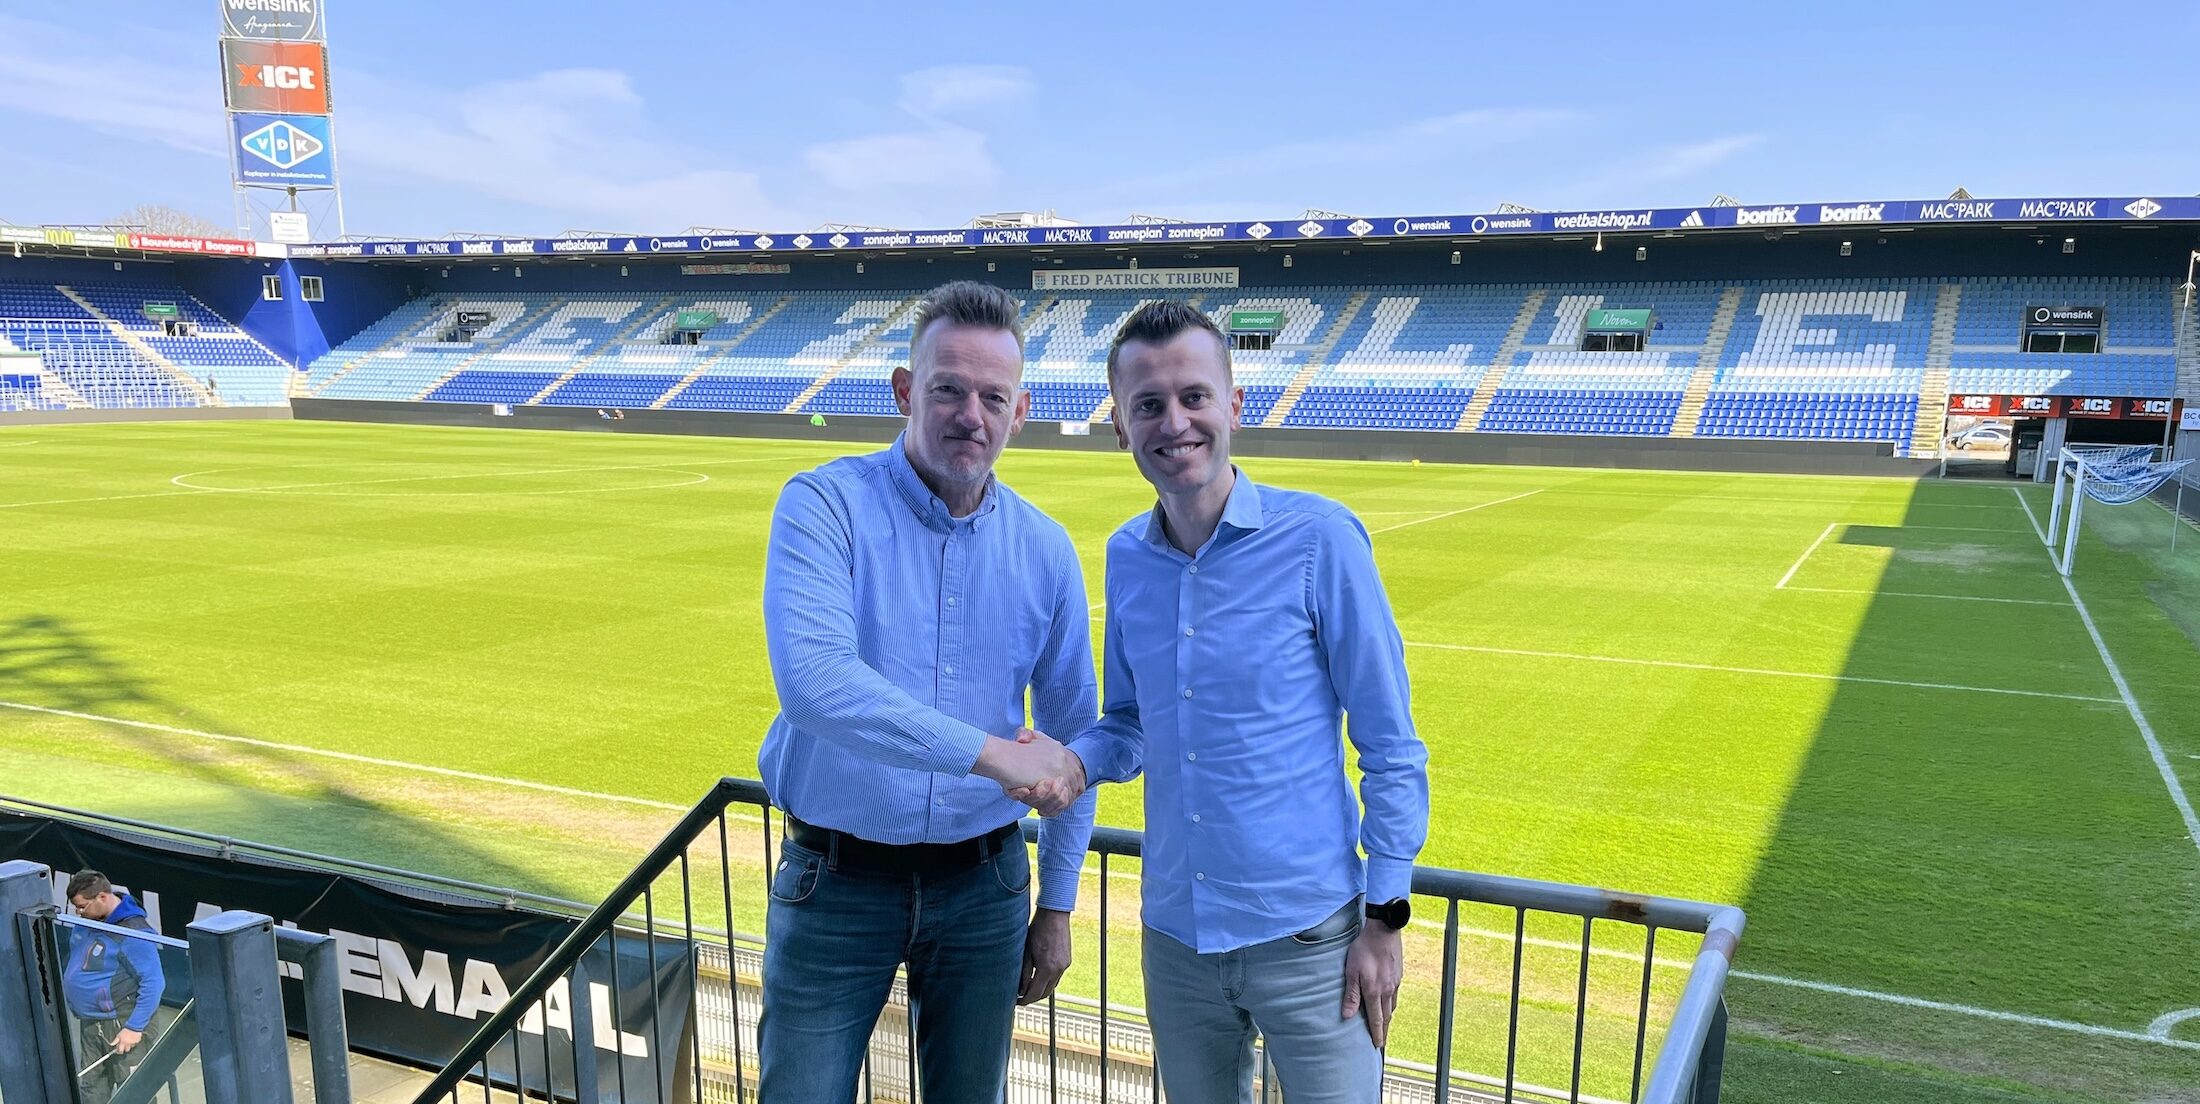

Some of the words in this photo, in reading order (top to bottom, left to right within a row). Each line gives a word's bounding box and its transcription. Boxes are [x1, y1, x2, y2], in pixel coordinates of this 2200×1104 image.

[256, 138, 309, 152] VDK
[1411, 220, 1450, 231] wensink
[1491, 218, 1532, 229] wensink
[1553, 210, 1652, 230] voetbalshop.nl
[863, 232, 910, 247] zonneplan
[915, 231, 964, 246] zonneplan
[1108, 226, 1162, 242] zonneplan
[1168, 225, 1224, 241] zonneplan
[141, 237, 202, 252] Bouwbedrijf
[205, 240, 245, 254] Bongers
[661, 239, 688, 249] wensink
[712, 238, 740, 248] wensink
[1052, 274, 1090, 286] FRED
[1095, 273, 1160, 286] PATRICK
[1166, 271, 1234, 285] TRIBUNE
[1240, 316, 1275, 325] zonneplan
[2052, 310, 2093, 319] wensink
